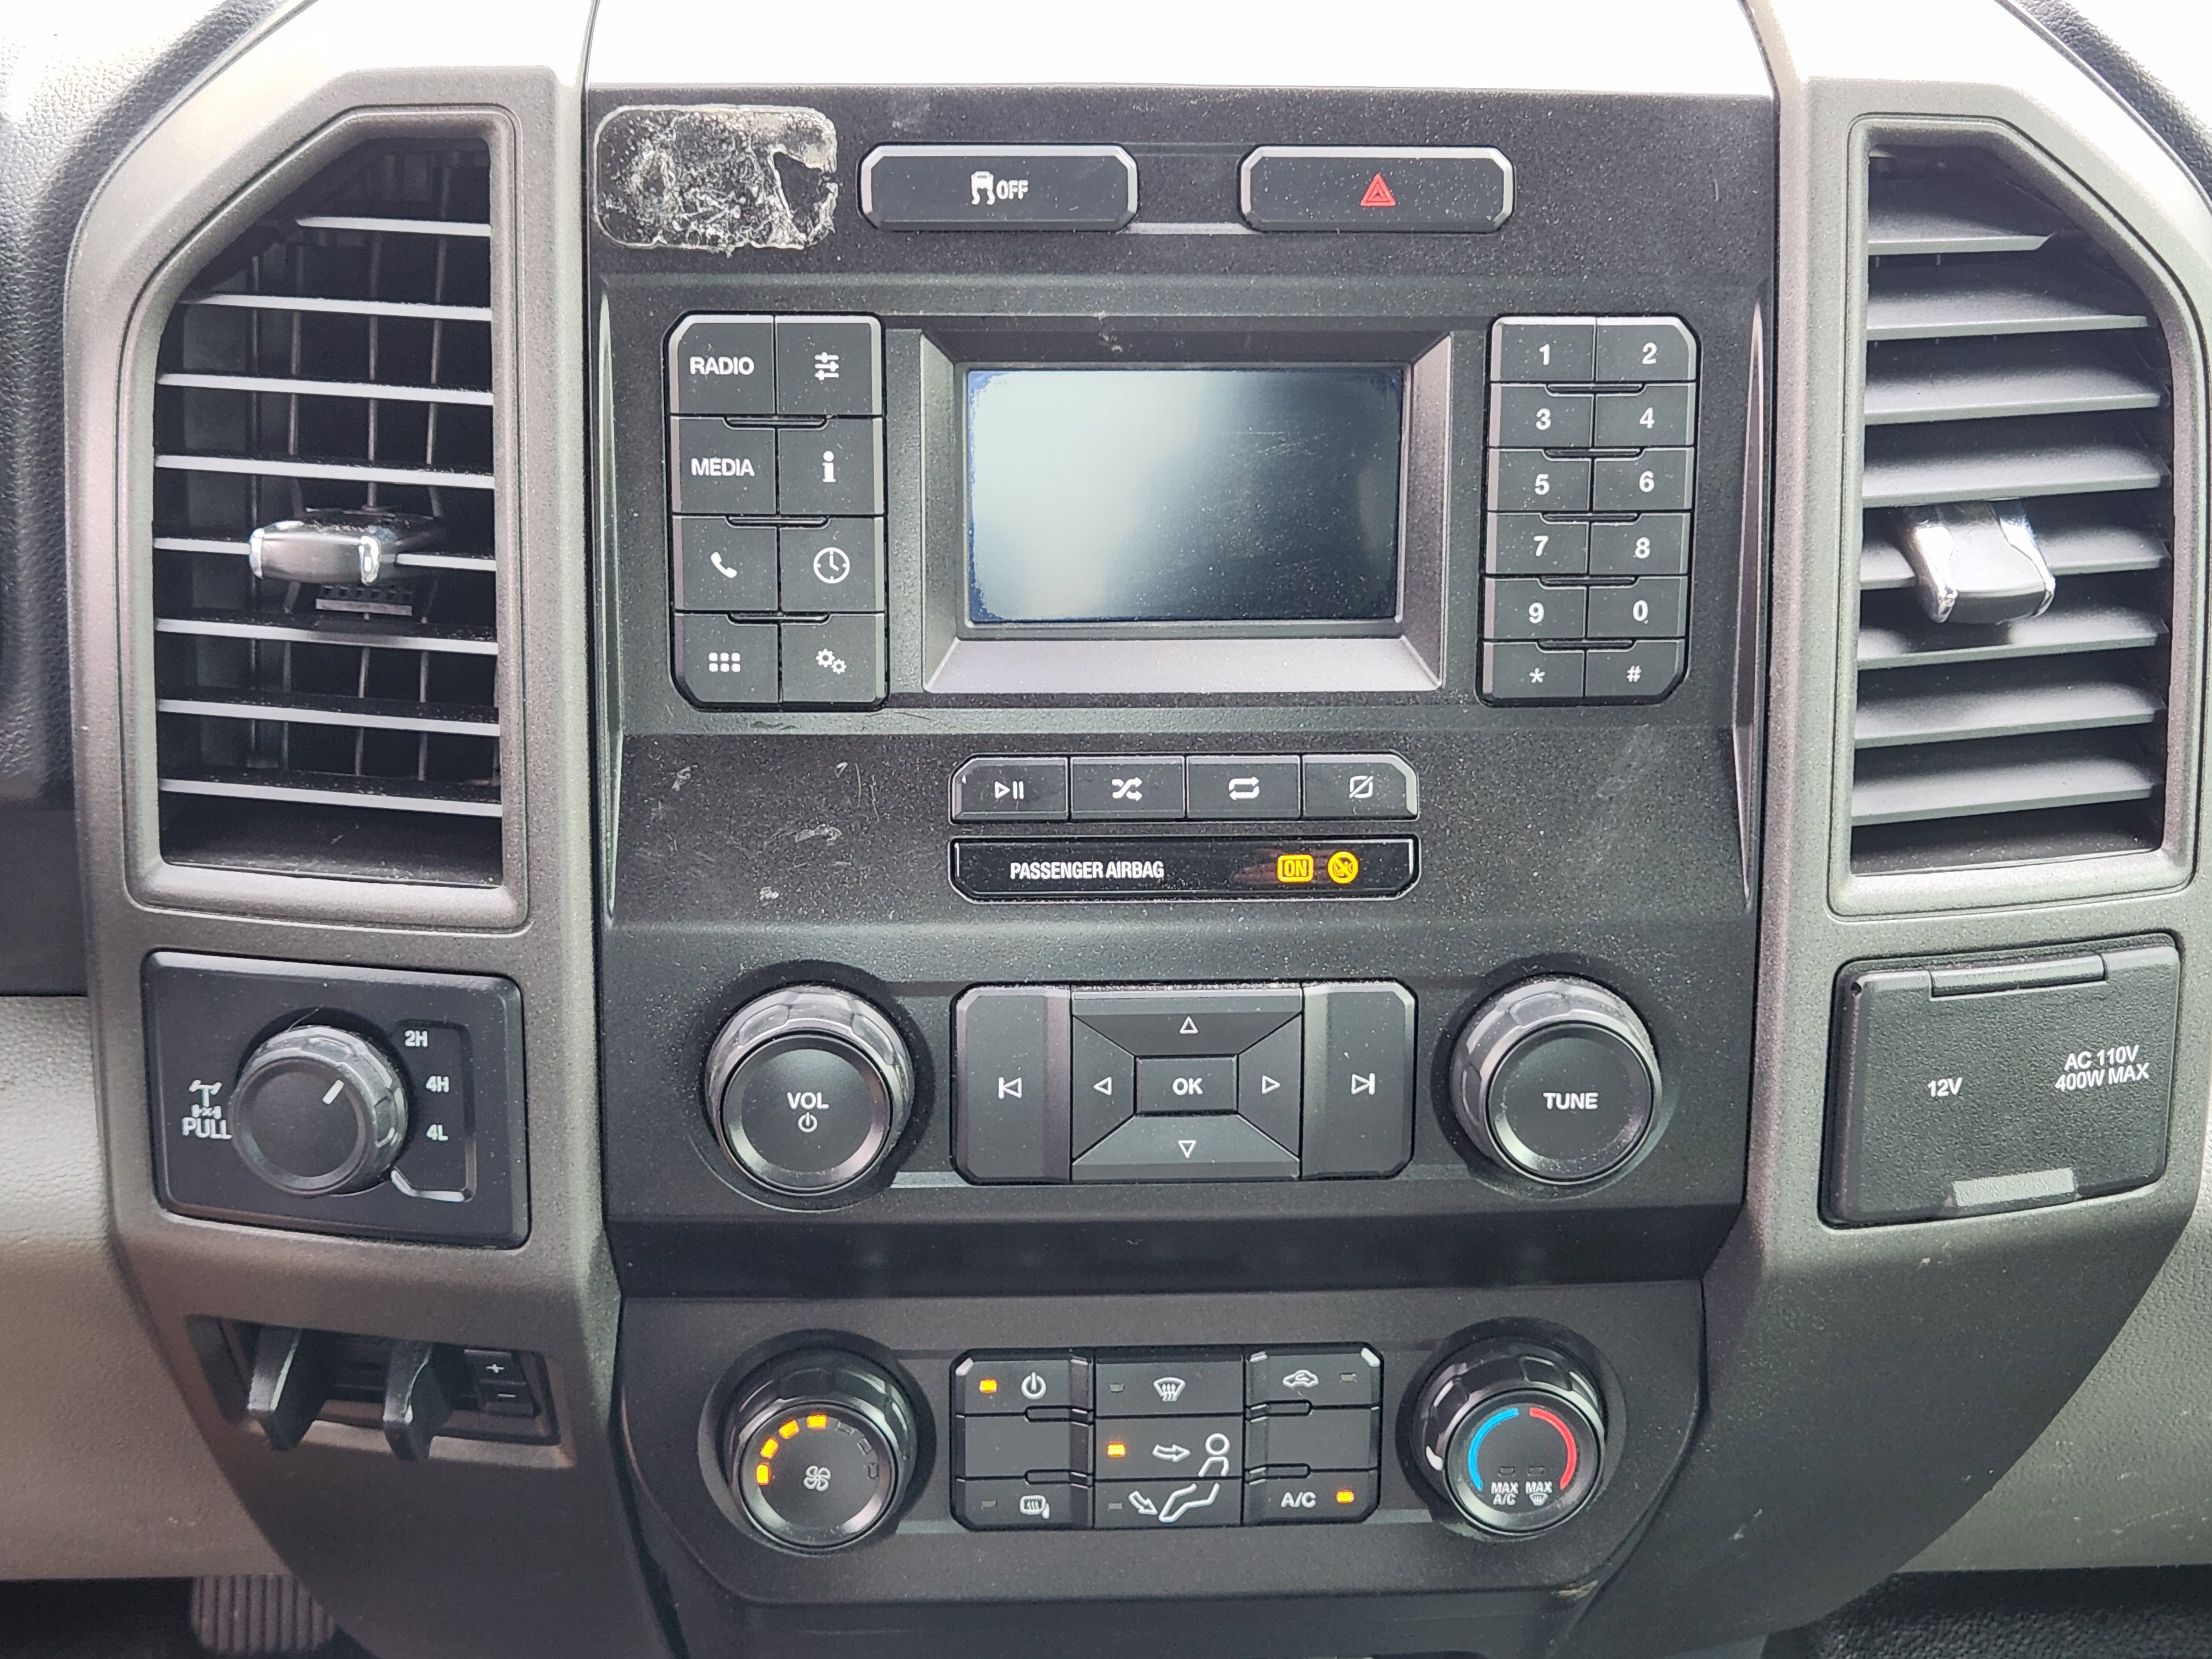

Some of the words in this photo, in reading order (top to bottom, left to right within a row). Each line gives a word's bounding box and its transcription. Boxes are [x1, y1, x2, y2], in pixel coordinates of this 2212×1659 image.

[997, 180, 1028, 199] OFF
[1540, 344, 1550, 365] 1
[1642, 343, 1657, 364] 2
[690, 357, 754, 375] RADIO
[1536, 409, 1551, 430] 3
[1640, 408, 1655, 429] 4
[692, 457, 755, 476] MEDIA
[1535, 474, 1550, 494] 5
[1640, 471, 1654, 492] 6
[1534, 536, 1548, 556] 7
[1635, 538, 1650, 559] 8
[1529, 603, 1544, 623] 9
[1633, 600, 1648, 621] 0
[1010, 862, 1104, 879] PASSENGER
[1106, 861, 1164, 878] AIRBAG
[1284, 859, 1307, 877] ON
[405, 1031, 427, 1047] 2H
[2064, 1052, 2093, 1071] AC
[2096, 1044, 2139, 1065] 110V
[426, 1076, 449, 1092] 4H
[1173, 1078, 1203, 1095] OK
[1928, 1077, 1963, 1097] 12V
[2054, 1070, 2103, 1092] 400W
[2109, 1063, 2150, 1081] MAX
[787, 1092, 829, 1109] VOL
[1543, 1093, 1598, 1109] TUNE
[182, 1118, 232, 1139] PULL
[427, 1124, 448, 1140] 4L
[1491, 1481, 1518, 1494] MAX
[1526, 1481, 1552, 1493] MAX
[1281, 1492, 1316, 1507] A/C
[1493, 1494, 1516, 1505] A/C
